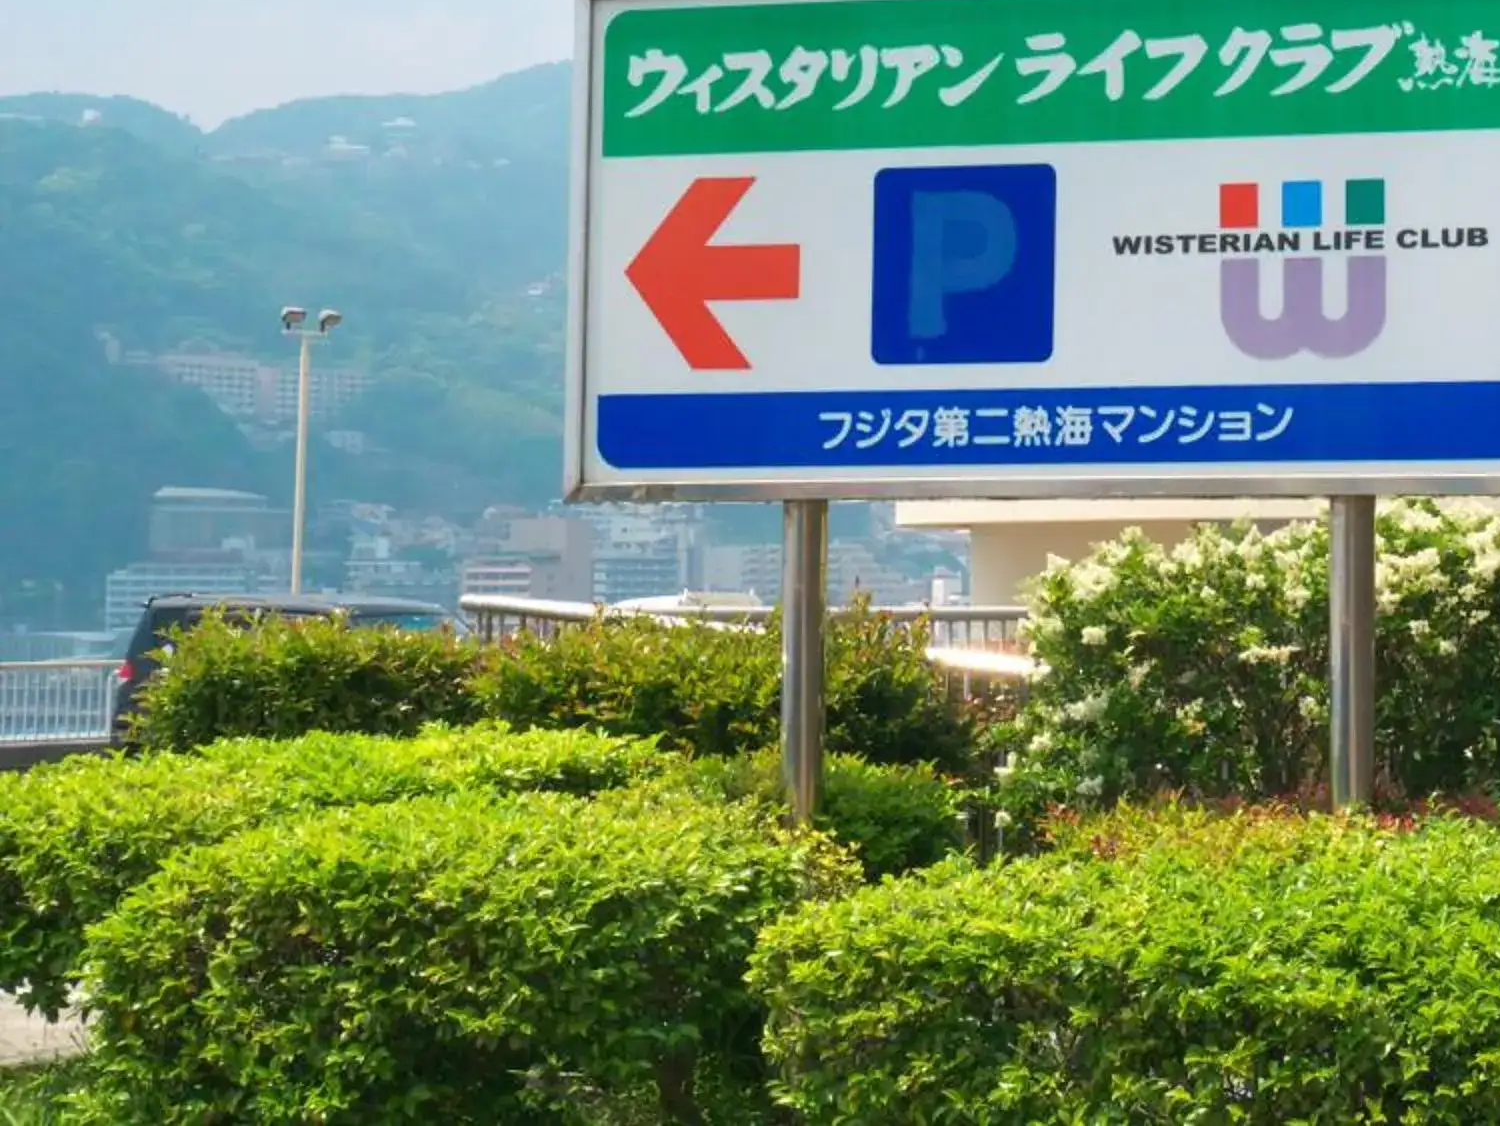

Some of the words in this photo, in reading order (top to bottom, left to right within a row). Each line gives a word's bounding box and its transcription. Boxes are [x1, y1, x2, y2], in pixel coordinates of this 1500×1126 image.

[1113, 233, 1299, 254] WISTERIAN
[1313, 229, 1385, 252] LIFE
[1396, 227, 1489, 249] CLUB
[909, 191, 1016, 337] P
[820, 405, 1292, 448] フジタ第二熱海マンション
